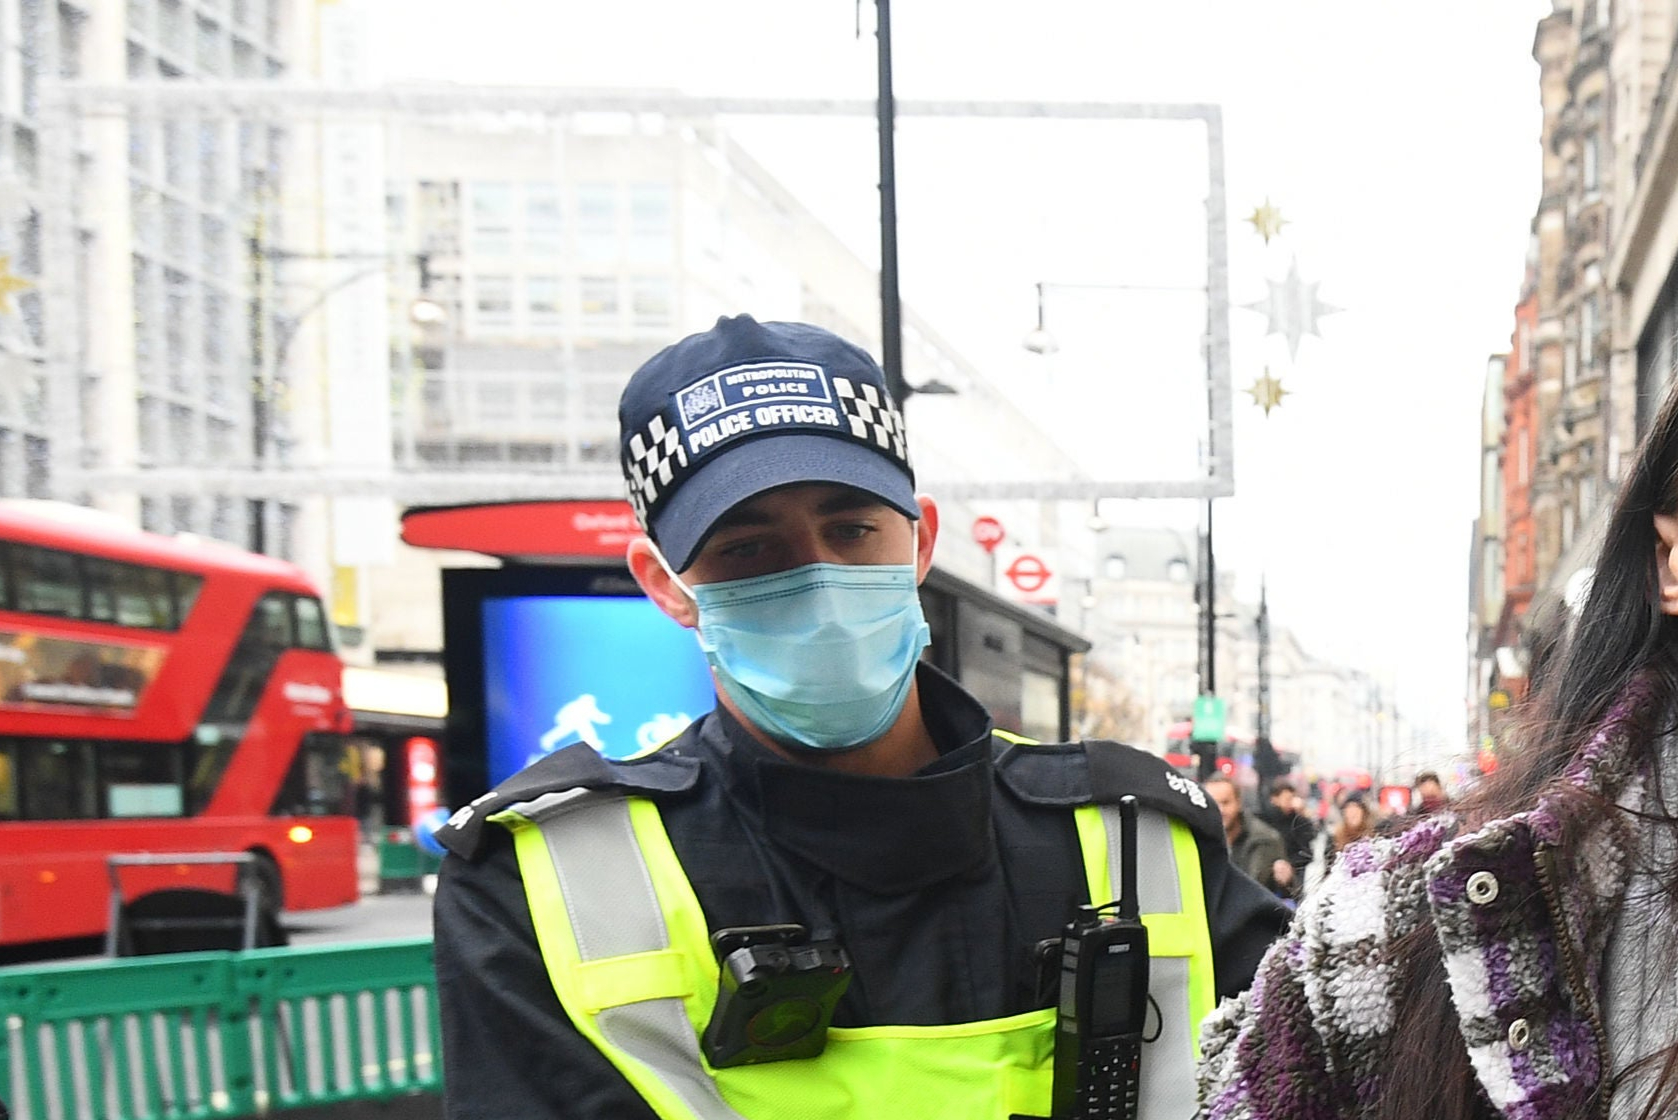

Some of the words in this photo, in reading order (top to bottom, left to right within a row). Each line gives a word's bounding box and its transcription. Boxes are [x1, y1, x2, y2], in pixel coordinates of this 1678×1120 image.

[726, 369, 816, 385] METROPOLITAN
[742, 383, 809, 397] POLICE
[688, 411, 753, 454] POLICE
[756, 405, 839, 427] OFFICER
